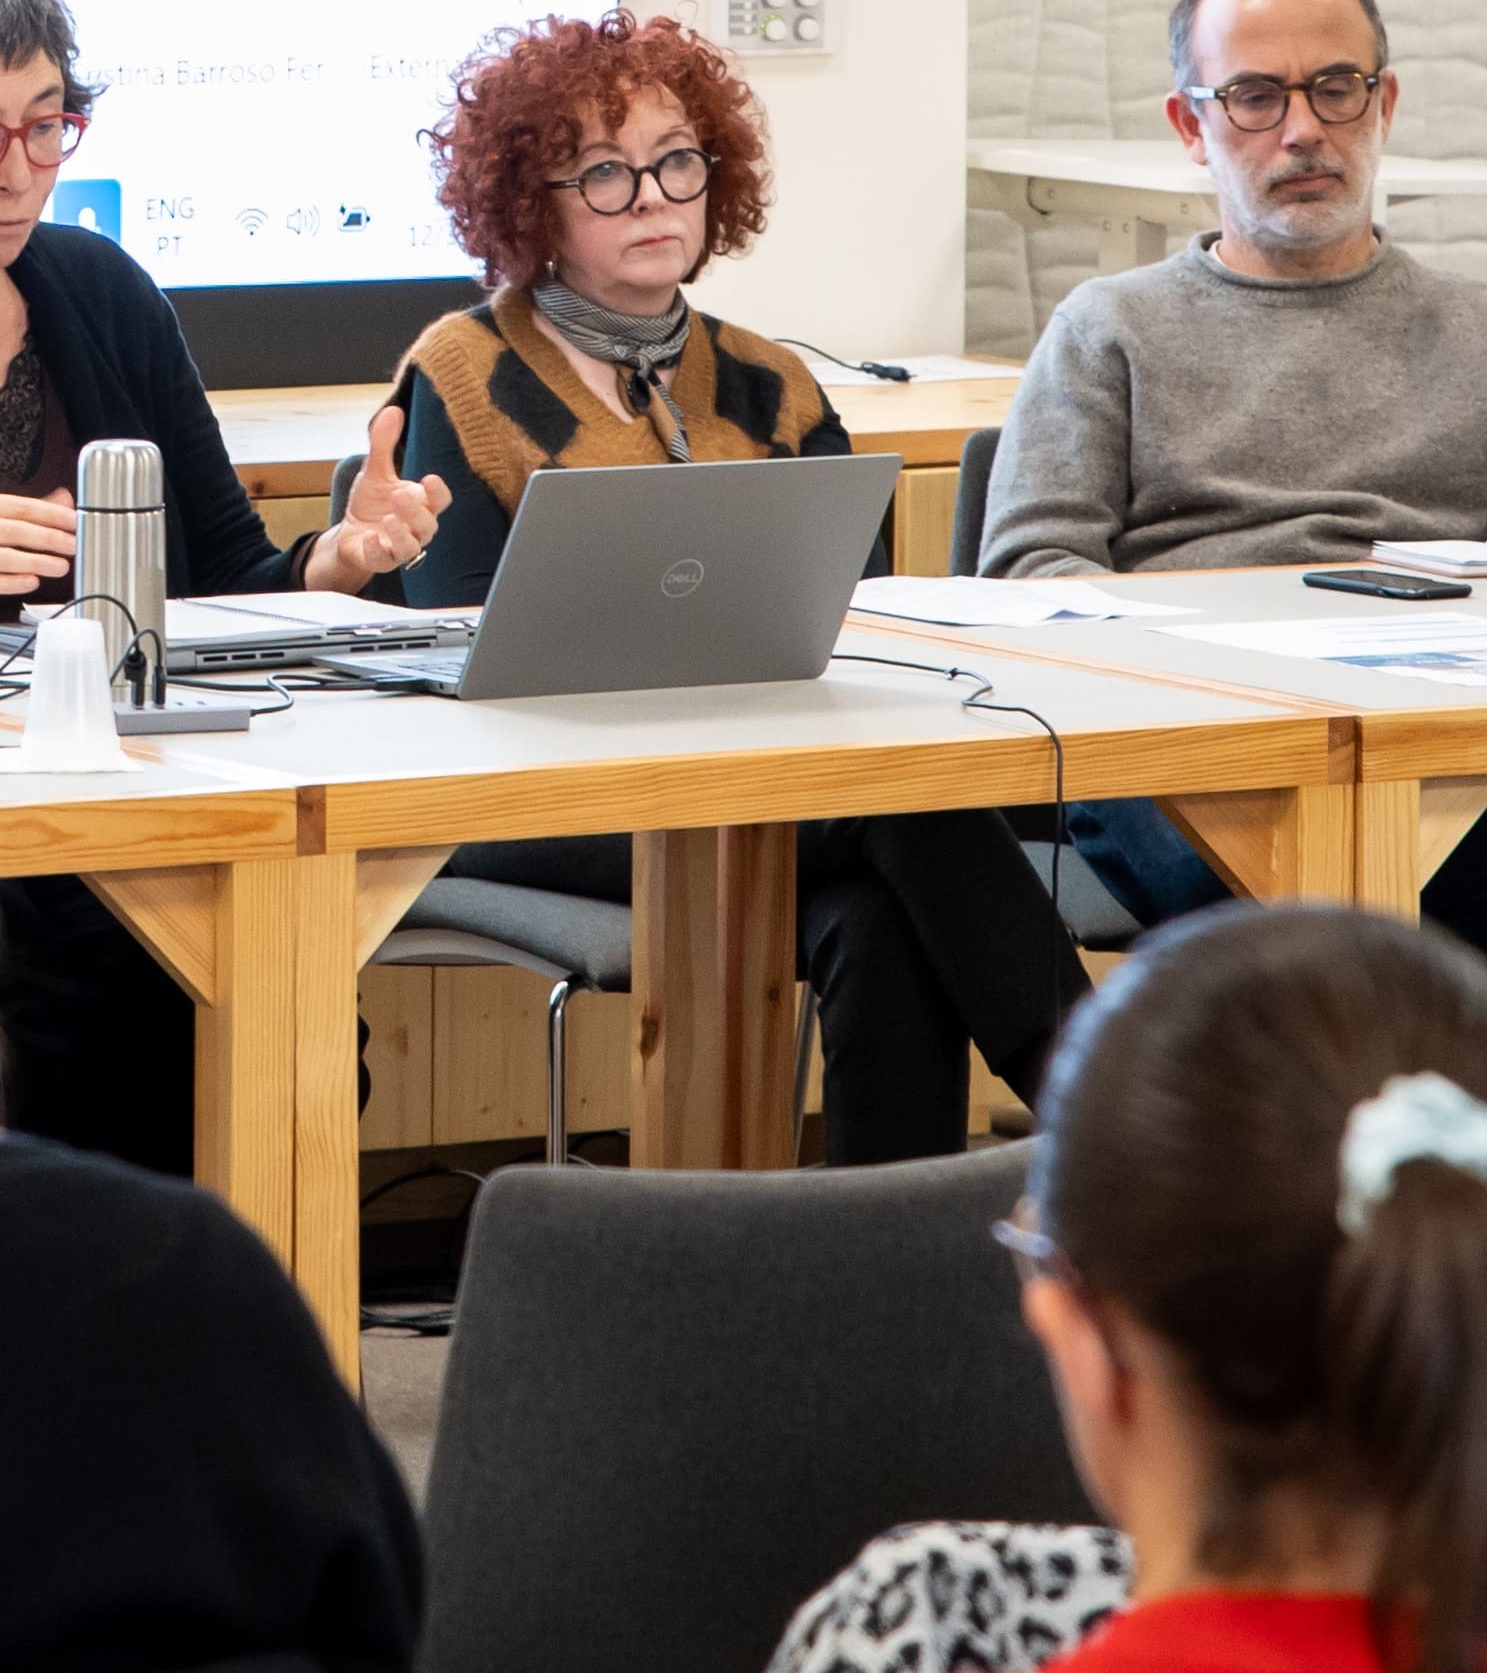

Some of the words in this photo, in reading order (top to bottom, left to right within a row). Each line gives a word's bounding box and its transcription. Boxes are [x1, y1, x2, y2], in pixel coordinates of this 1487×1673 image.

[146, 196, 196, 221] ENG
[156, 234, 183, 257] PT
[668, 572, 698, 584] DELL
